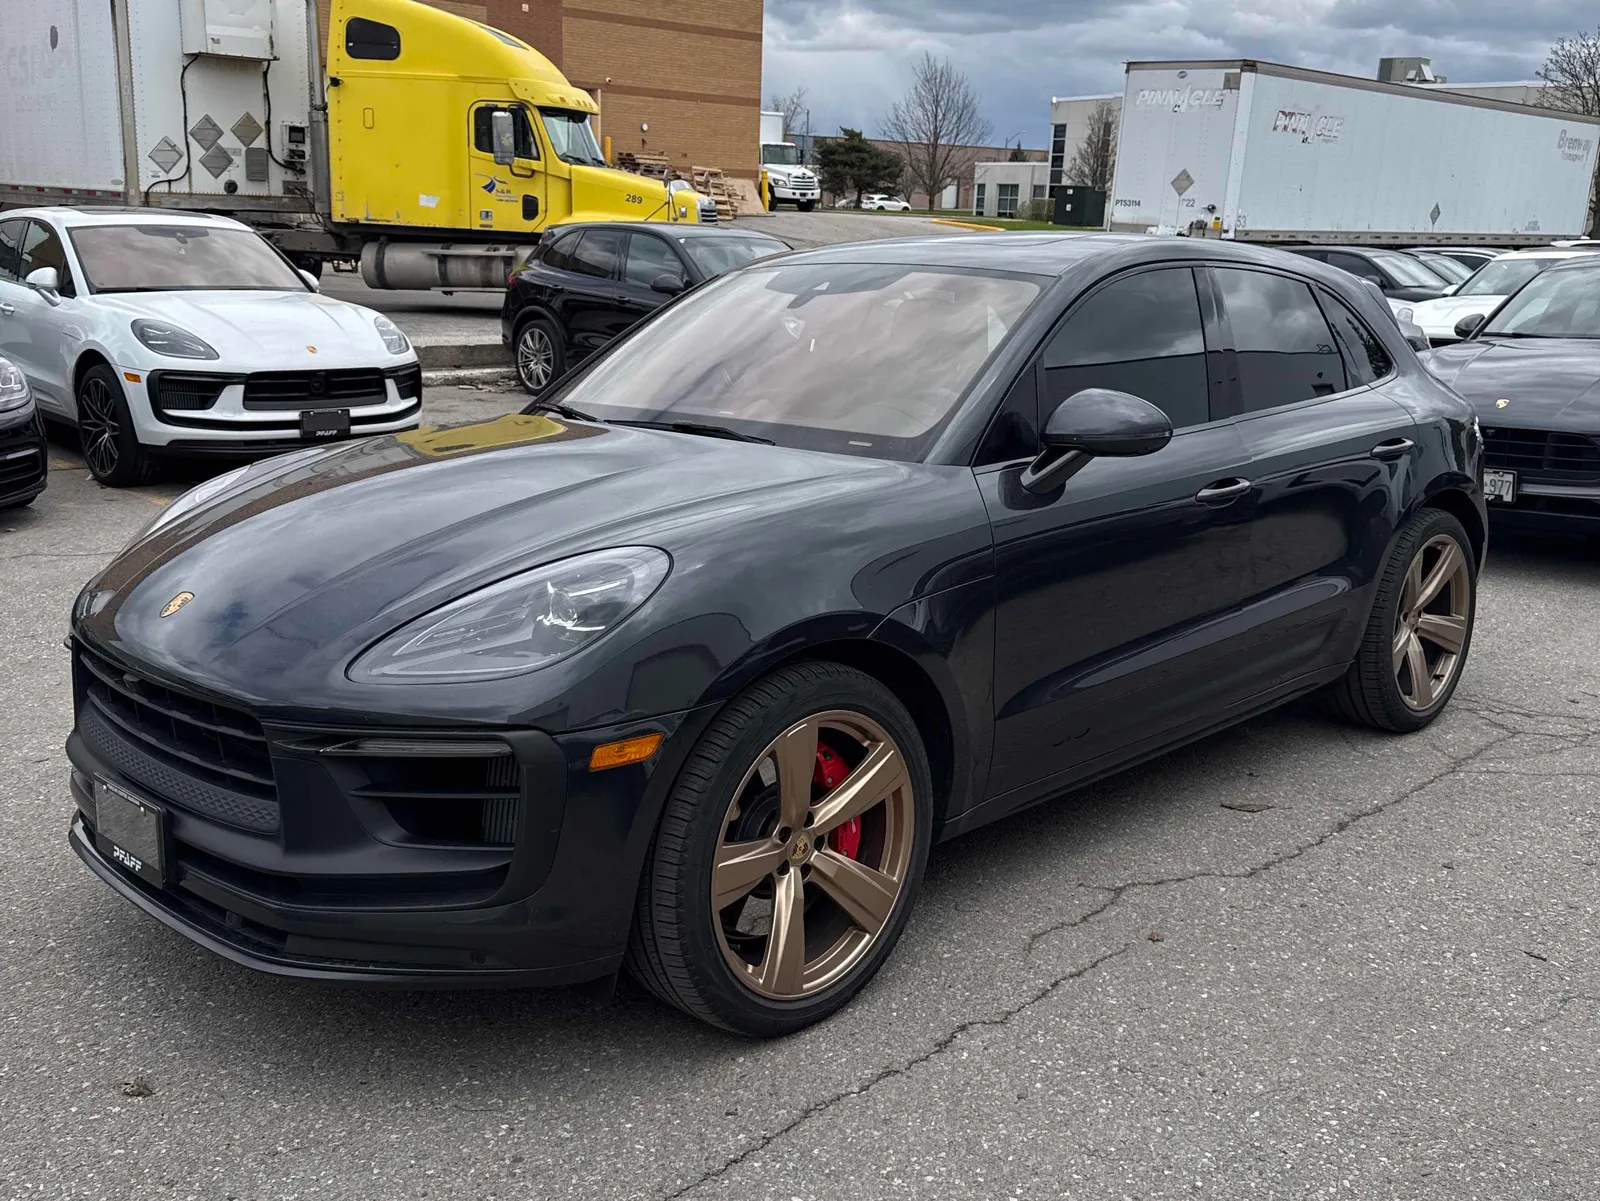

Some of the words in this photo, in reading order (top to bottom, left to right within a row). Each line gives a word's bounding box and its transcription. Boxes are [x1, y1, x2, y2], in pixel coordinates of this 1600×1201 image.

[1136, 85, 1224, 113] PINNACLE
[1557, 129, 1593, 167] Brenway
[625, 194, 643, 204] 289
[1115, 199, 1141, 207] PT53114
[1489, 479, 1512, 496] 977
[113, 845, 142, 872] PFAFF
